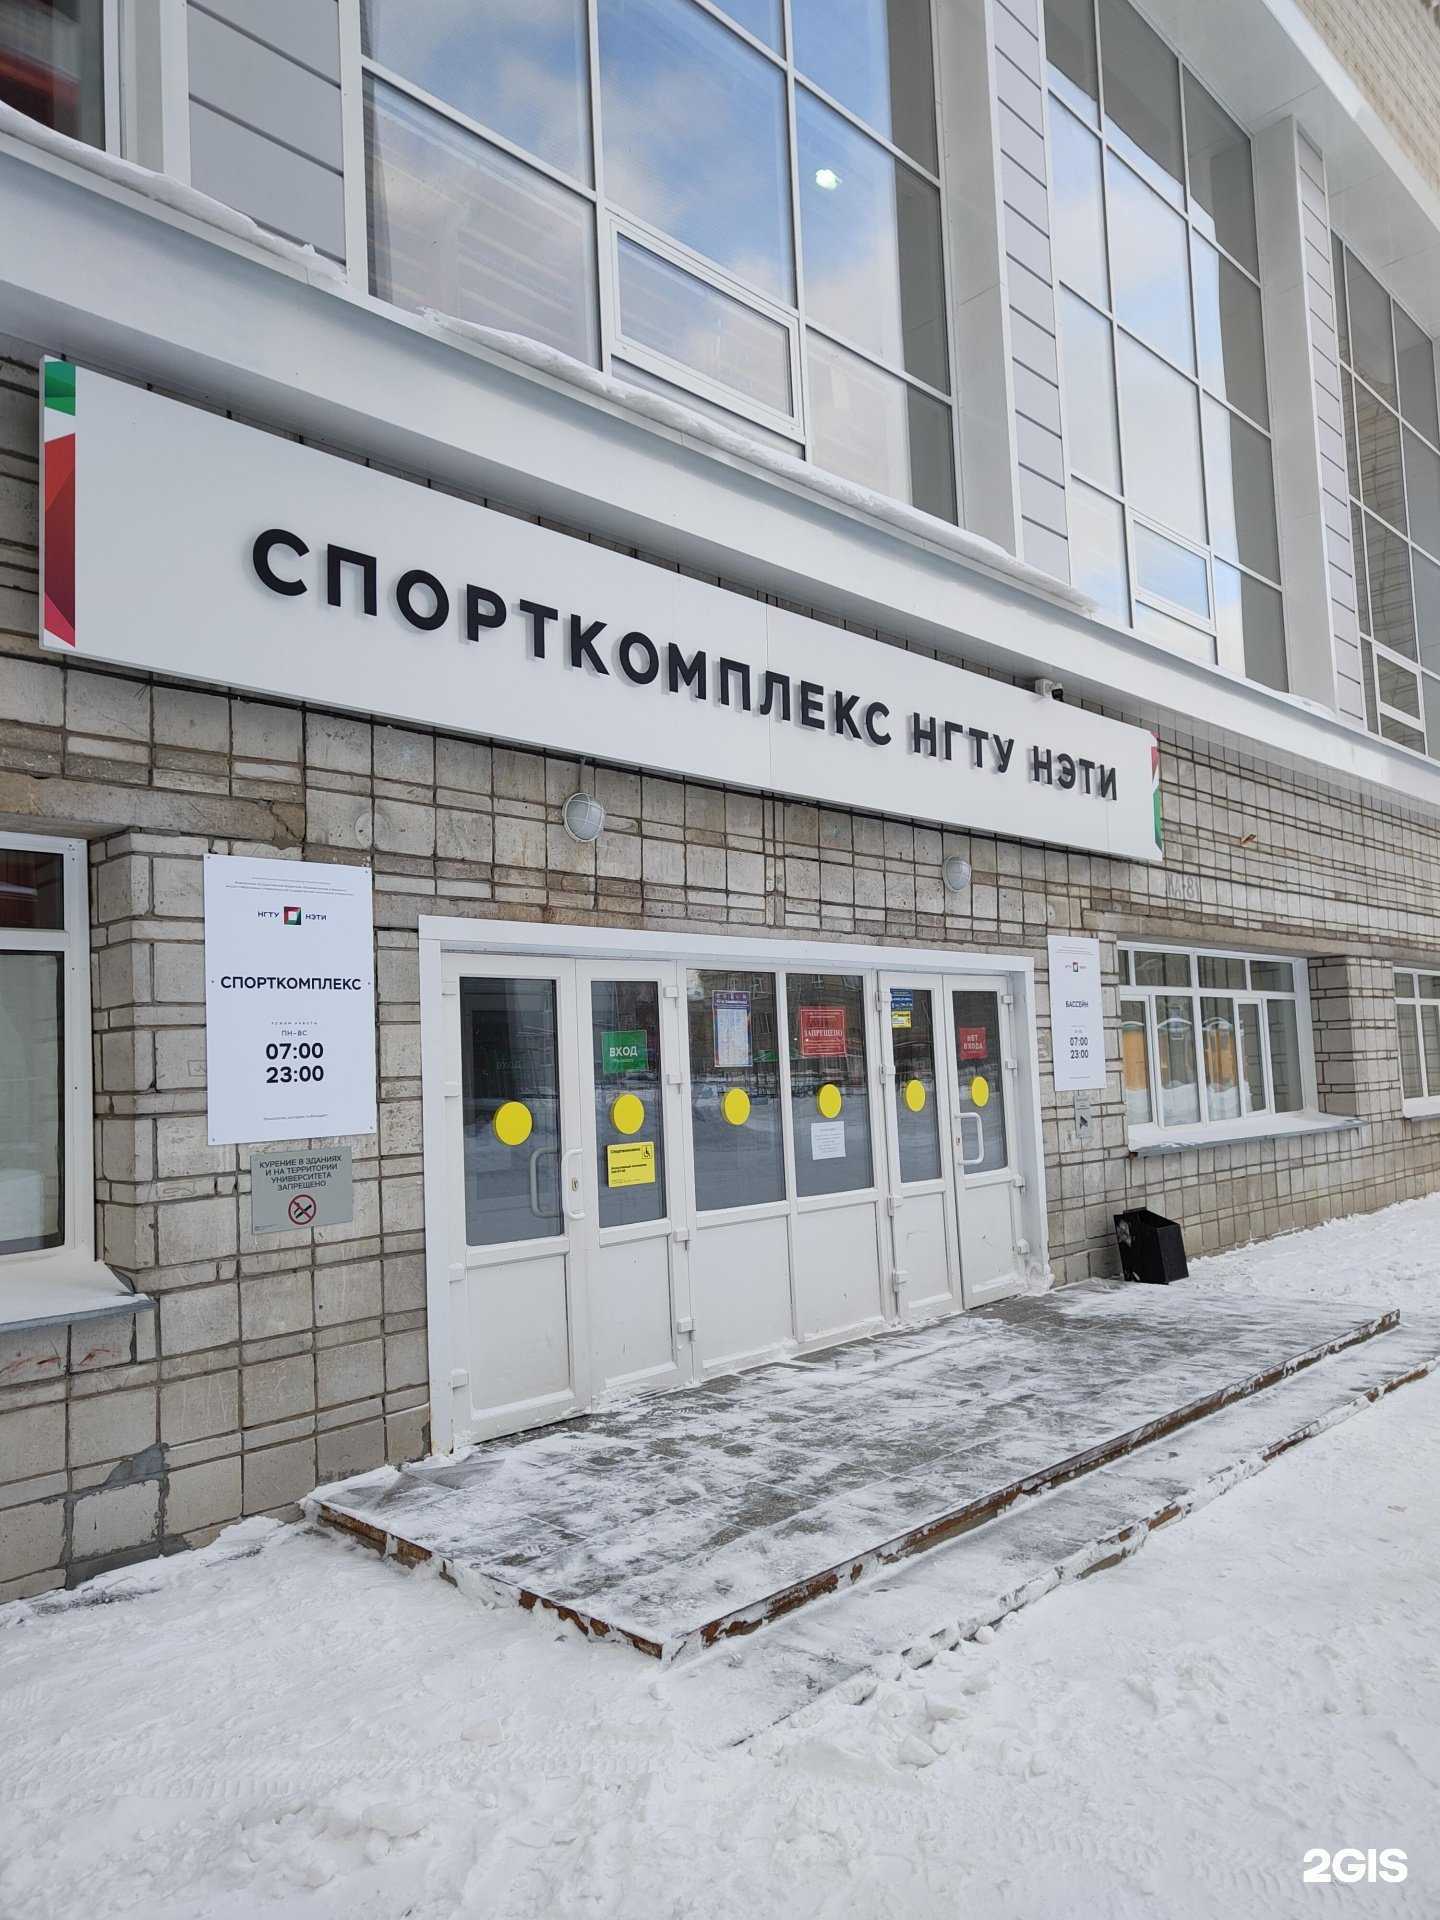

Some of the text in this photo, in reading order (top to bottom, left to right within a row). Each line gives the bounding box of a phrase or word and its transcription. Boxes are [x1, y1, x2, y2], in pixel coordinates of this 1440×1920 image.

[253, 528, 1117, 801] СПОРТКОМПЛЕКС НГТУ НЭТИ
[220, 976, 362, 990] СПОРТКОМПЛЕКС
[1065, 1000, 1089, 1009] БАССЕЙН
[1069, 1036, 1089, 1046] 07:00
[266, 1042, 324, 1060] 07:00
[609, 1046, 638, 1057] ВХОД
[1070, 1049, 1089, 1059] 23:00
[266, 1065, 324, 1084] 23:00
[259, 1154, 342, 1169] КУРЕНИЕ В ЗДАНИЯХ
[273, 1168, 285, 1176] НА
[287, 1163, 338, 1174] ТЕРРИТОРИИ
[271, 1171, 333, 1184] УНИВЕРСИТЕТА
